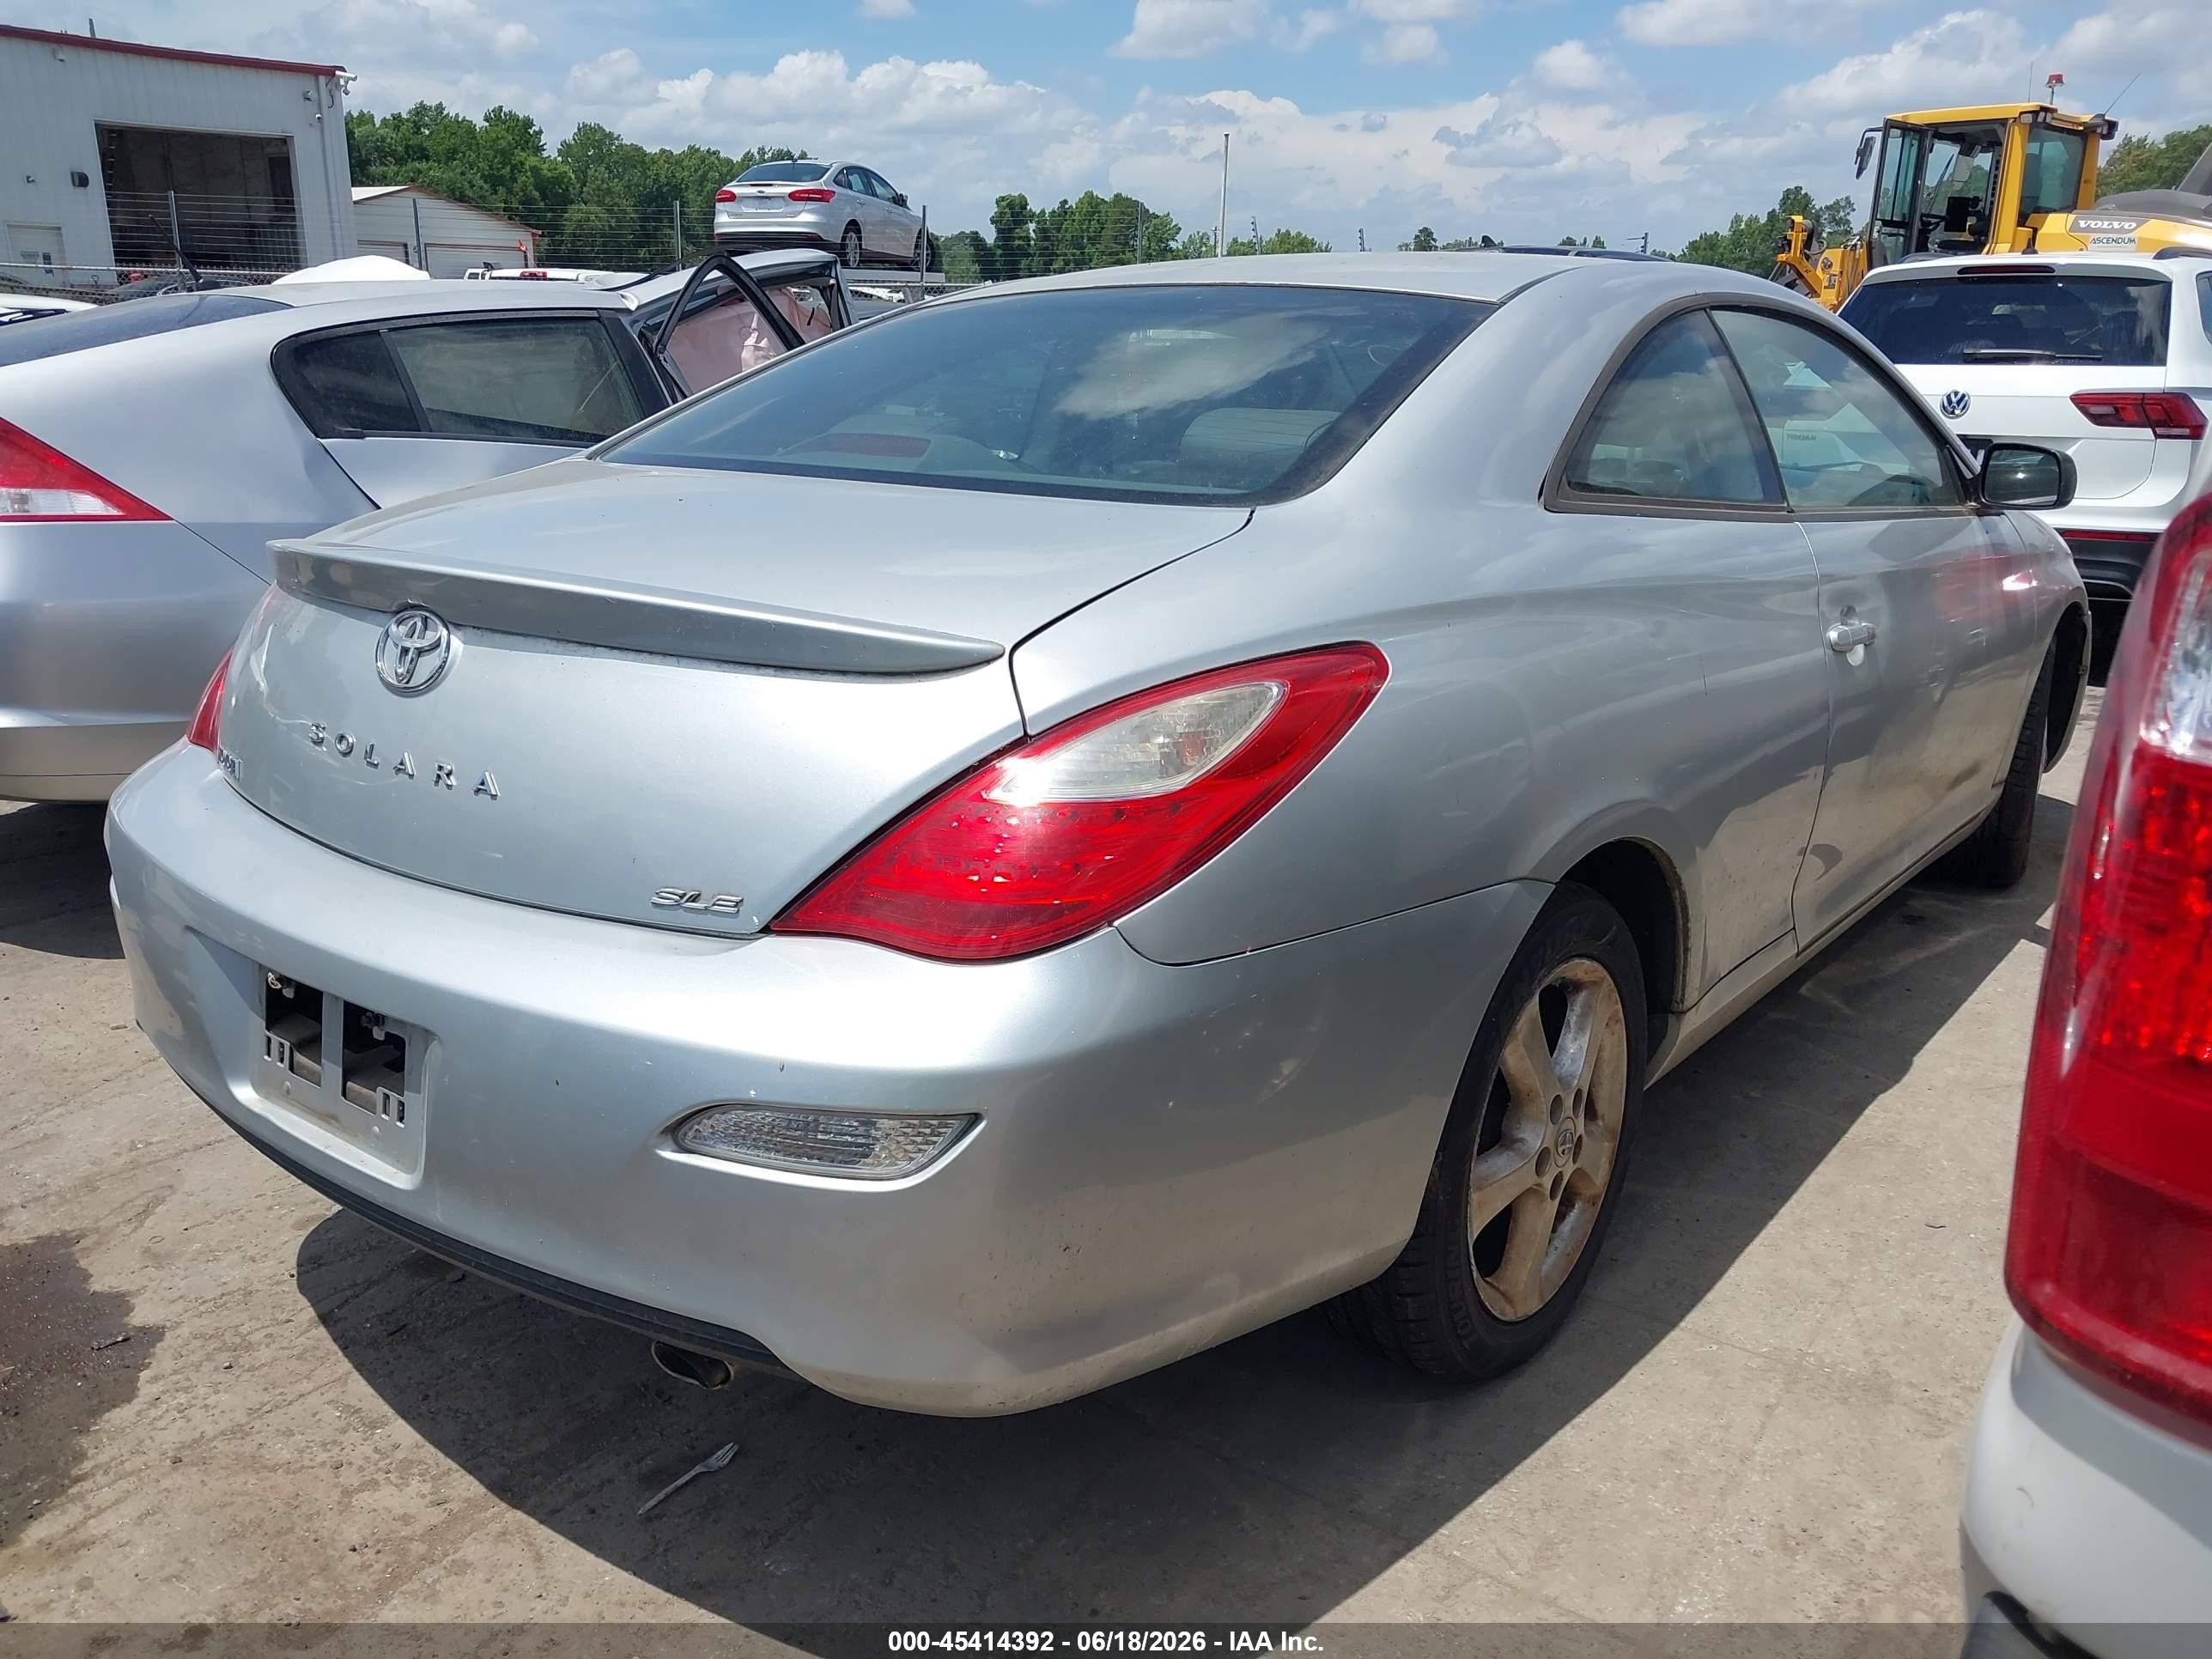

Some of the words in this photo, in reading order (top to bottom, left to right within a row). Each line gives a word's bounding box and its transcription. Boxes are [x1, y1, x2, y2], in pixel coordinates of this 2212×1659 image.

[2078, 220, 2136, 229] VOLVO
[308, 721, 501, 800] SOLARA
[651, 886, 744, 915] SLE
